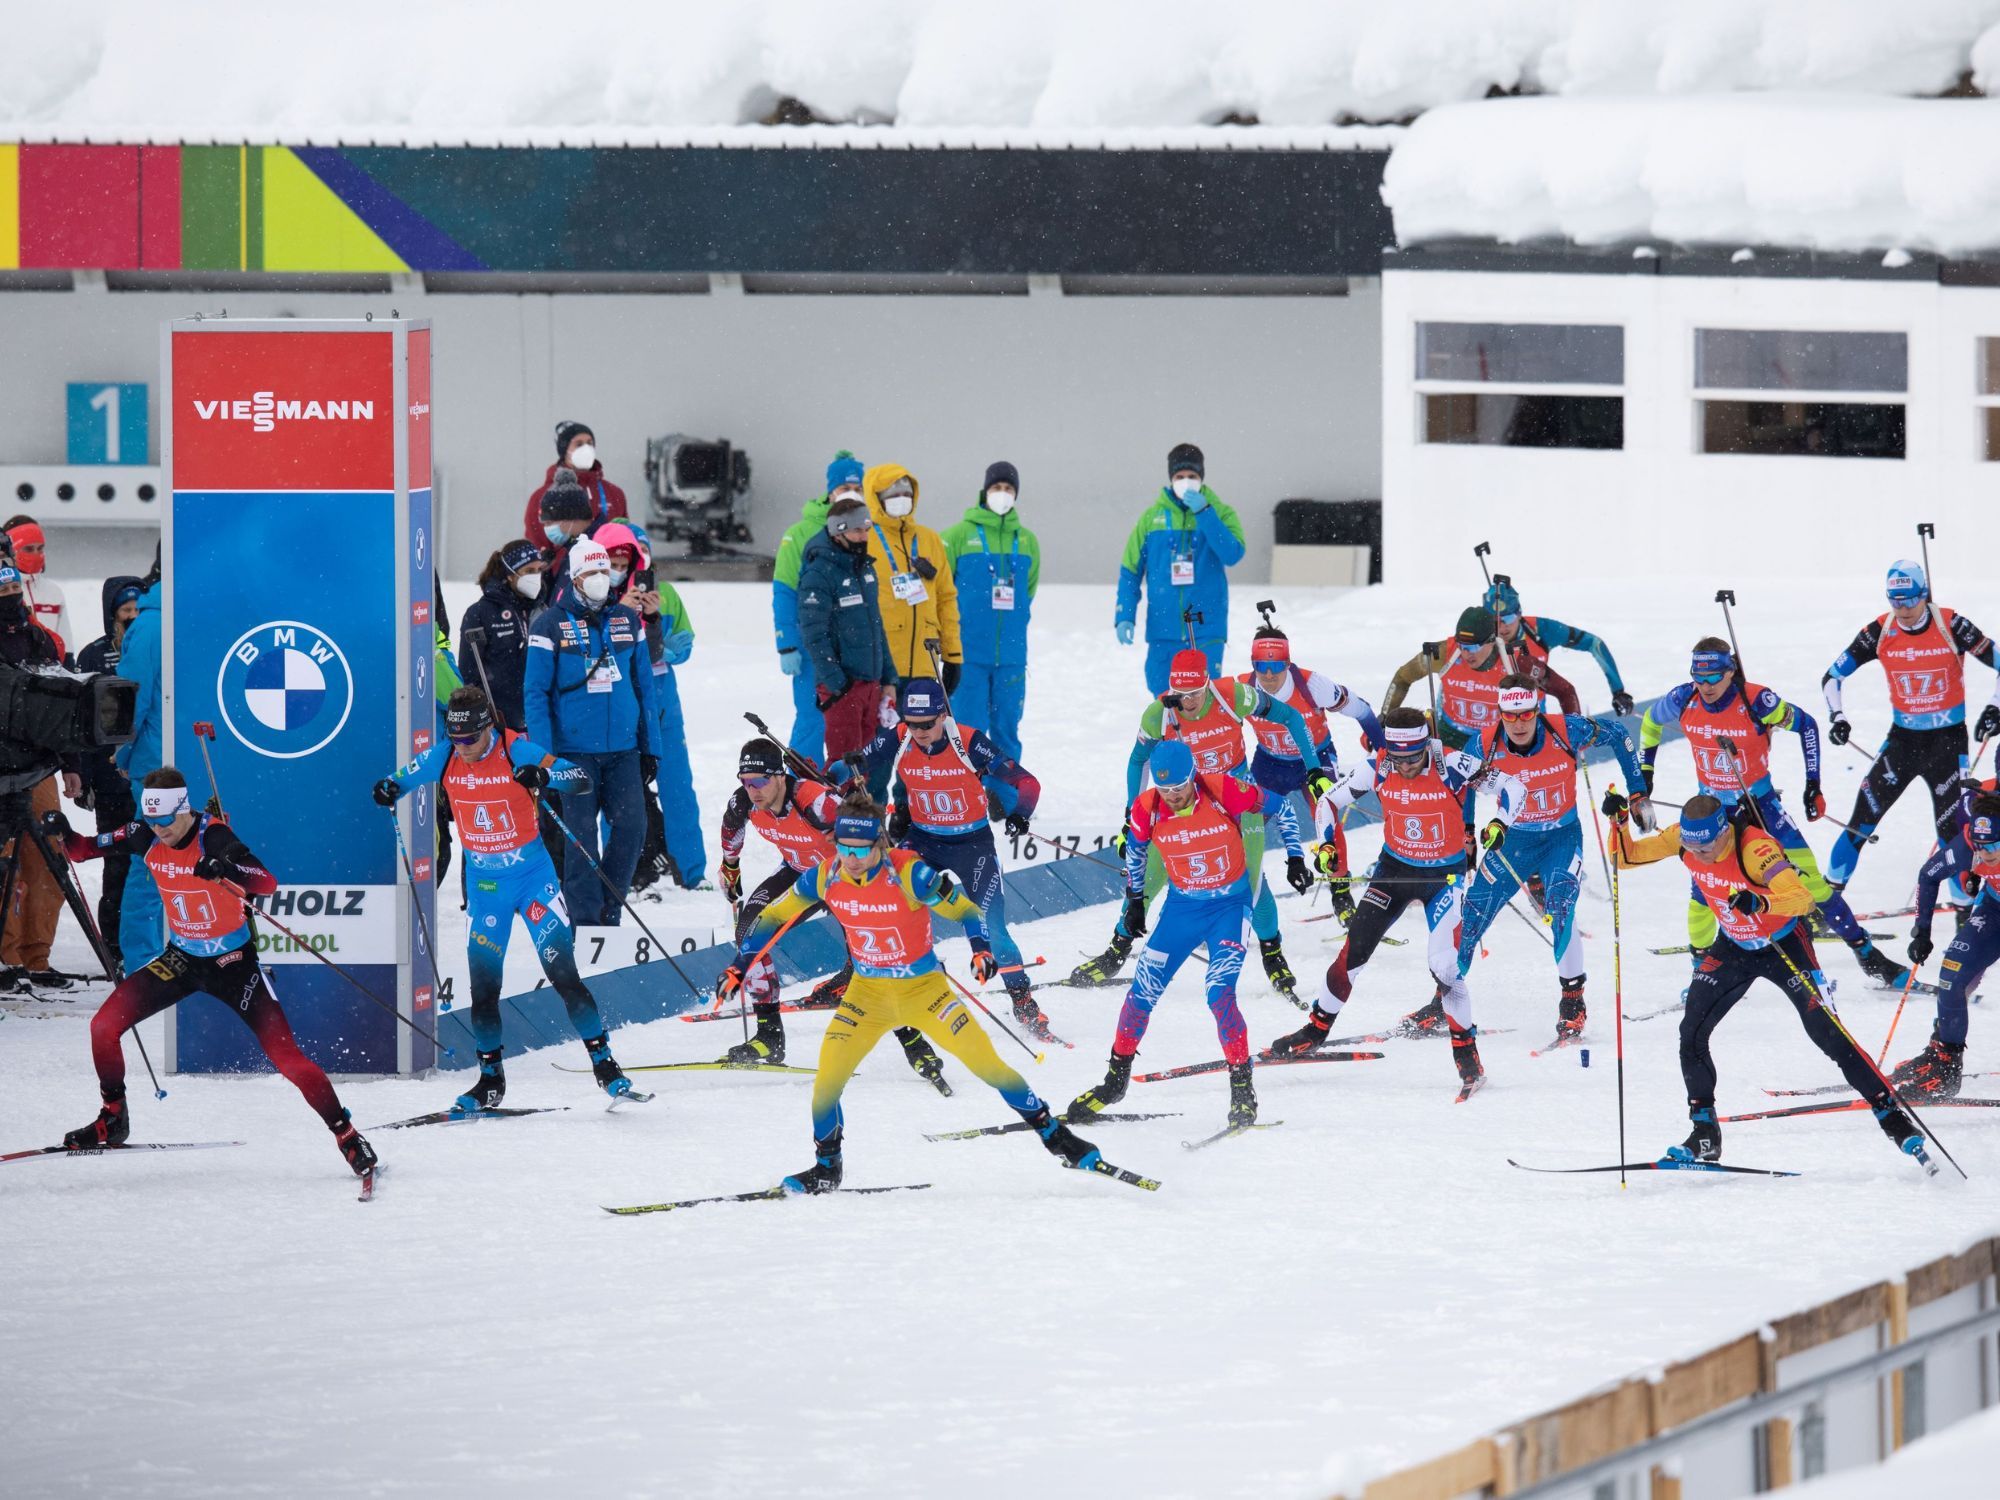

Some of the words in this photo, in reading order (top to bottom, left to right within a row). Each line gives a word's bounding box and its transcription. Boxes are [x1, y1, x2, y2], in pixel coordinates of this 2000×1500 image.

[193, 391, 374, 432] VIESSMANN
[90, 387, 120, 462] 1
[236, 628, 335, 666] BMW
[1886, 647, 1951, 662] VIESSMANN
[1447, 678, 1500, 693] VIESSMAN
[1899, 673, 1933, 695] 17
[1935, 679, 1945, 692] 1
[1501, 691, 1533, 701] HARVIA
[1455, 699, 1488, 719] 19
[1686, 724, 1747, 740] VIESSMANN
[1513, 762, 1569, 783] ESSMANN
[1697, 749, 1732, 774] 14
[448, 773, 510, 790] VIESSMANN
[552, 768, 588, 781] FRANCE
[903, 766, 966, 781] VIESSMANN
[917, 791, 953, 814] 10
[953, 797, 964, 812] 1
[1381, 788, 1447, 805] VIESSMANN
[474, 805, 495, 832] 4
[498, 813, 510, 830] 1
[1404, 816, 1424, 841] 8
[1431, 823, 1441, 841] 1
[465, 831, 518, 843] ANTERSELVA
[755, 825, 813, 843] VIESSMANN
[1158, 823, 1229, 845] VIESSMANN
[1009, 834, 1039, 861] 16
[1053, 835, 1081, 861] 17
[1188, 853, 1208, 878] 5
[1215, 856, 1225, 871] 1
[1689, 871, 1748, 889] VIESSMANN
[172, 893, 190, 923] 1
[199, 904, 210, 921] 1
[830, 899, 899, 917] VIESSMANN
[1715, 898, 1737, 925] 3
[590, 937, 606, 965] 7
[634, 937, 650, 965] 8
[856, 929, 882, 954] 2
[886, 936, 899, 951] 1
[240, 972, 260, 1011] odlo
[437, 977, 455, 1001] 4
[720, 1063, 760, 1071] FISCHER
[66, 1149, 104, 1157] MADSHUS
